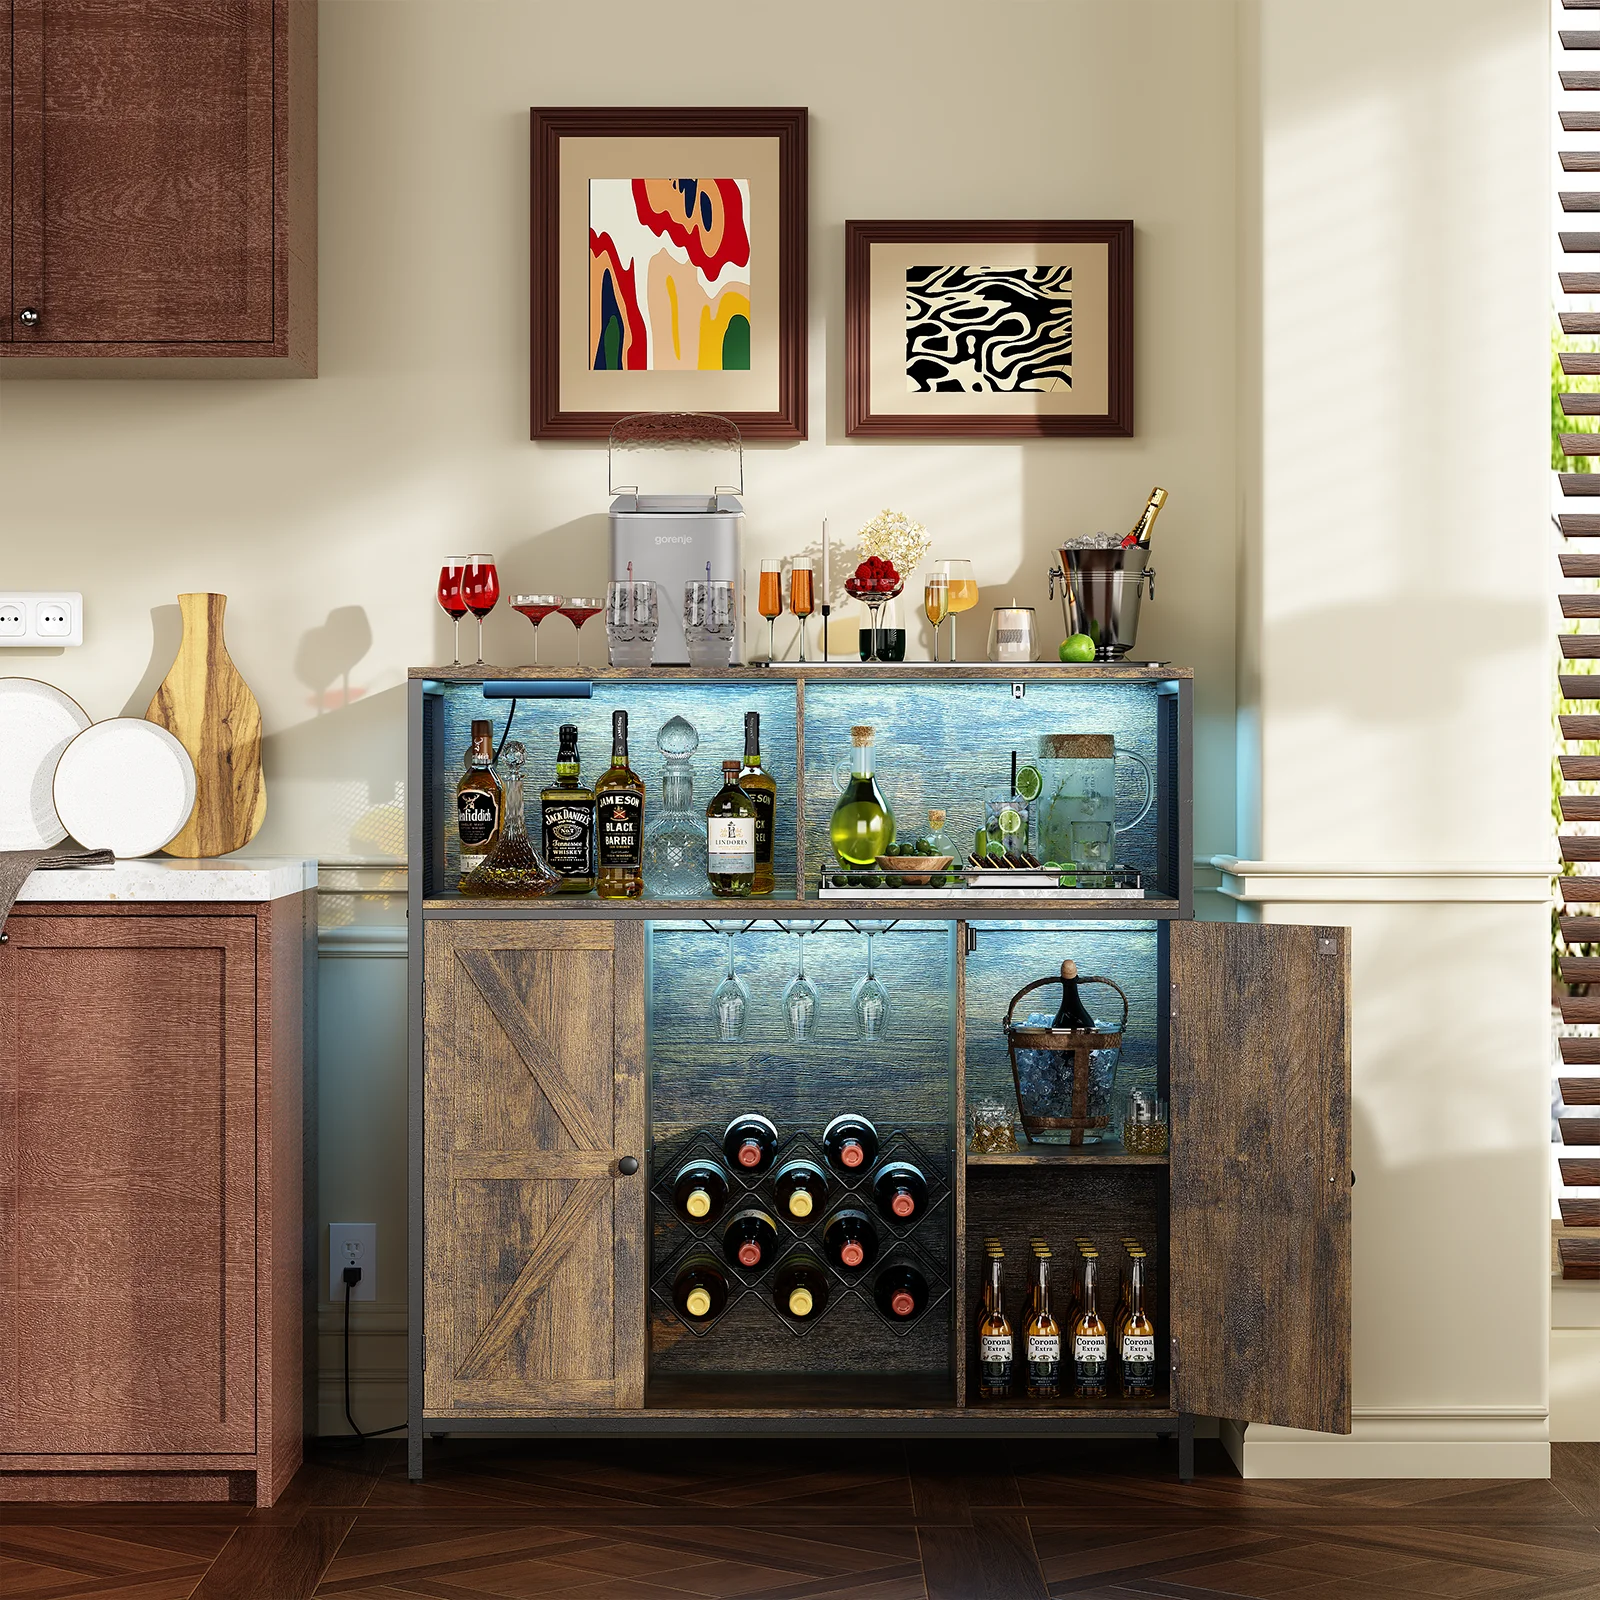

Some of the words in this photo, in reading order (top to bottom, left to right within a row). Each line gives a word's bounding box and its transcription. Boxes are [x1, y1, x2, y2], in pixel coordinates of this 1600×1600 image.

[654, 534, 693, 545] gorenje
[599, 795, 640, 808] JAMESON
[750, 794, 771, 806] ESON
[545, 811, 563, 826] JACK
[563, 809, 592, 826] DANIEL'S
[605, 822, 634, 832] BLACK
[552, 839, 583, 847] Tennessee
[605, 836, 634, 846] BARREL
[982, 1337, 1011, 1346] Corona
[1029, 1337, 1058, 1346] Corona
[1076, 1337, 1105, 1346] Corona
[1124, 1337, 1153, 1346] Corona
